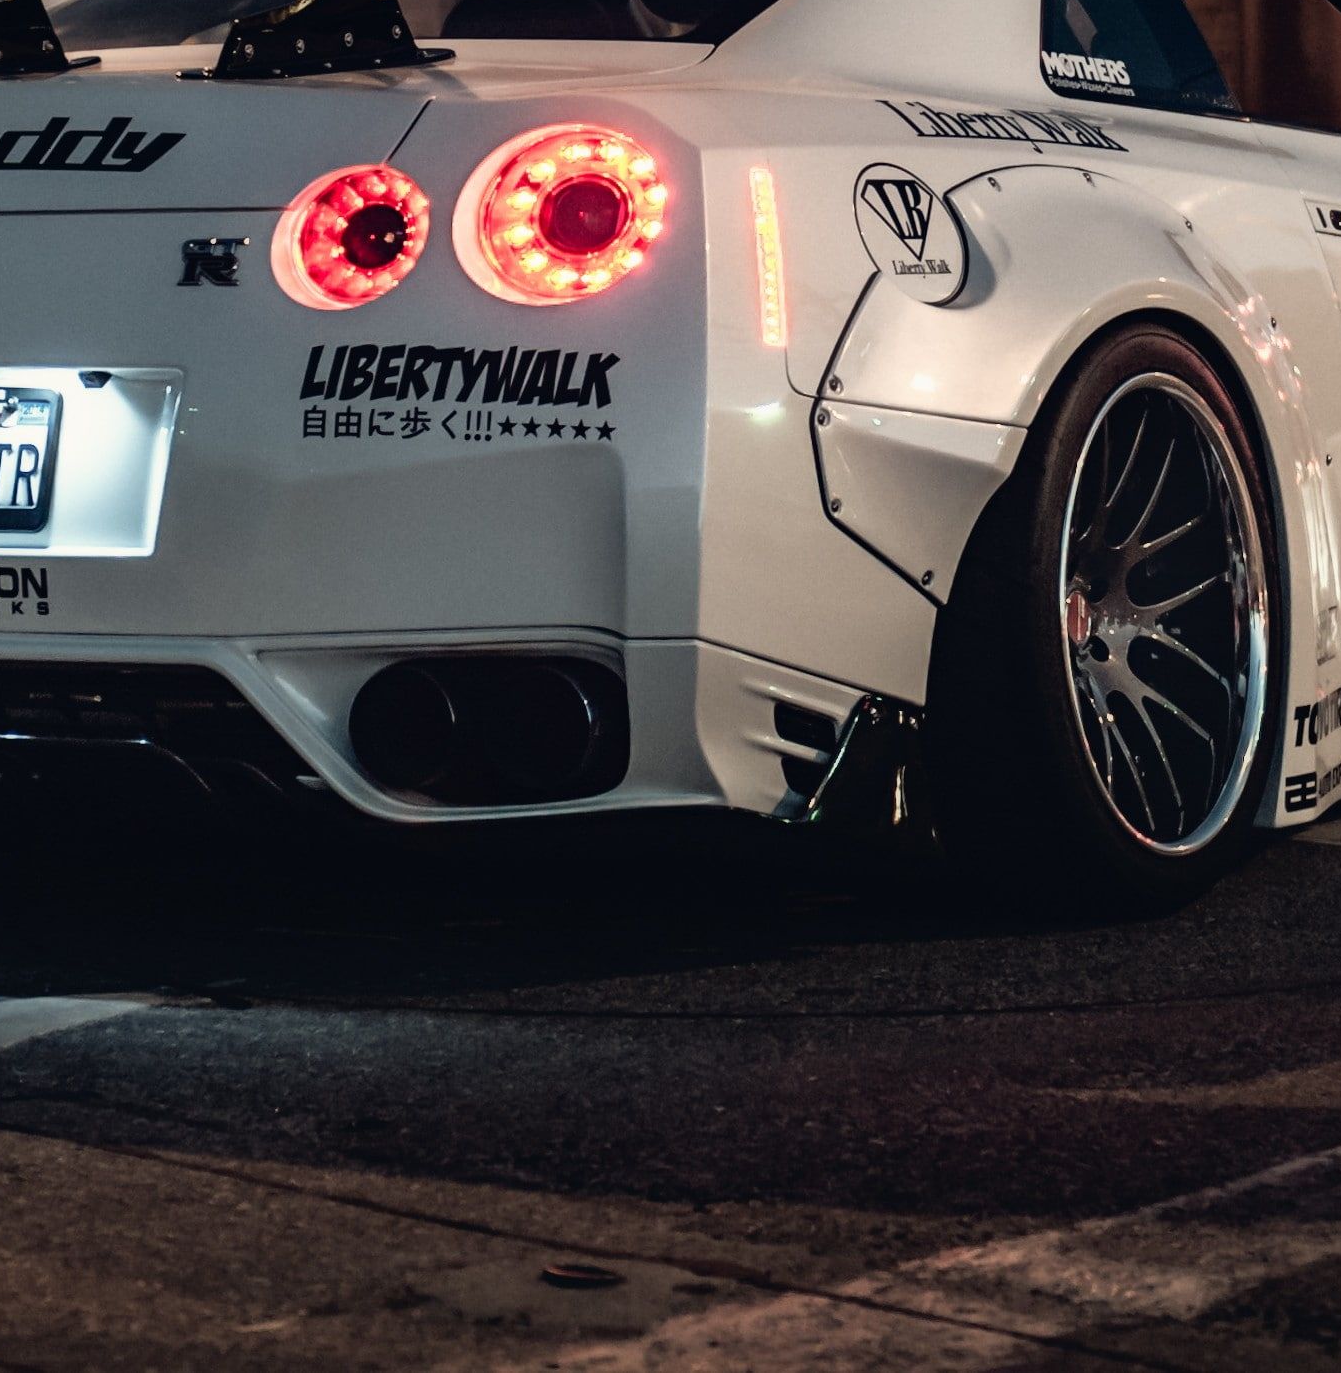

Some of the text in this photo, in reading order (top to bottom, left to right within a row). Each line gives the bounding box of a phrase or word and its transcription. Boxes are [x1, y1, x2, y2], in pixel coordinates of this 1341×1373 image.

[1041, 51, 1132, 85] MOTHERS
[875, 100, 1129, 154] Liberty Walk
[892, 259, 952, 279] Liberty Walk
[299, 344, 621, 409] LIBERTYWALK
